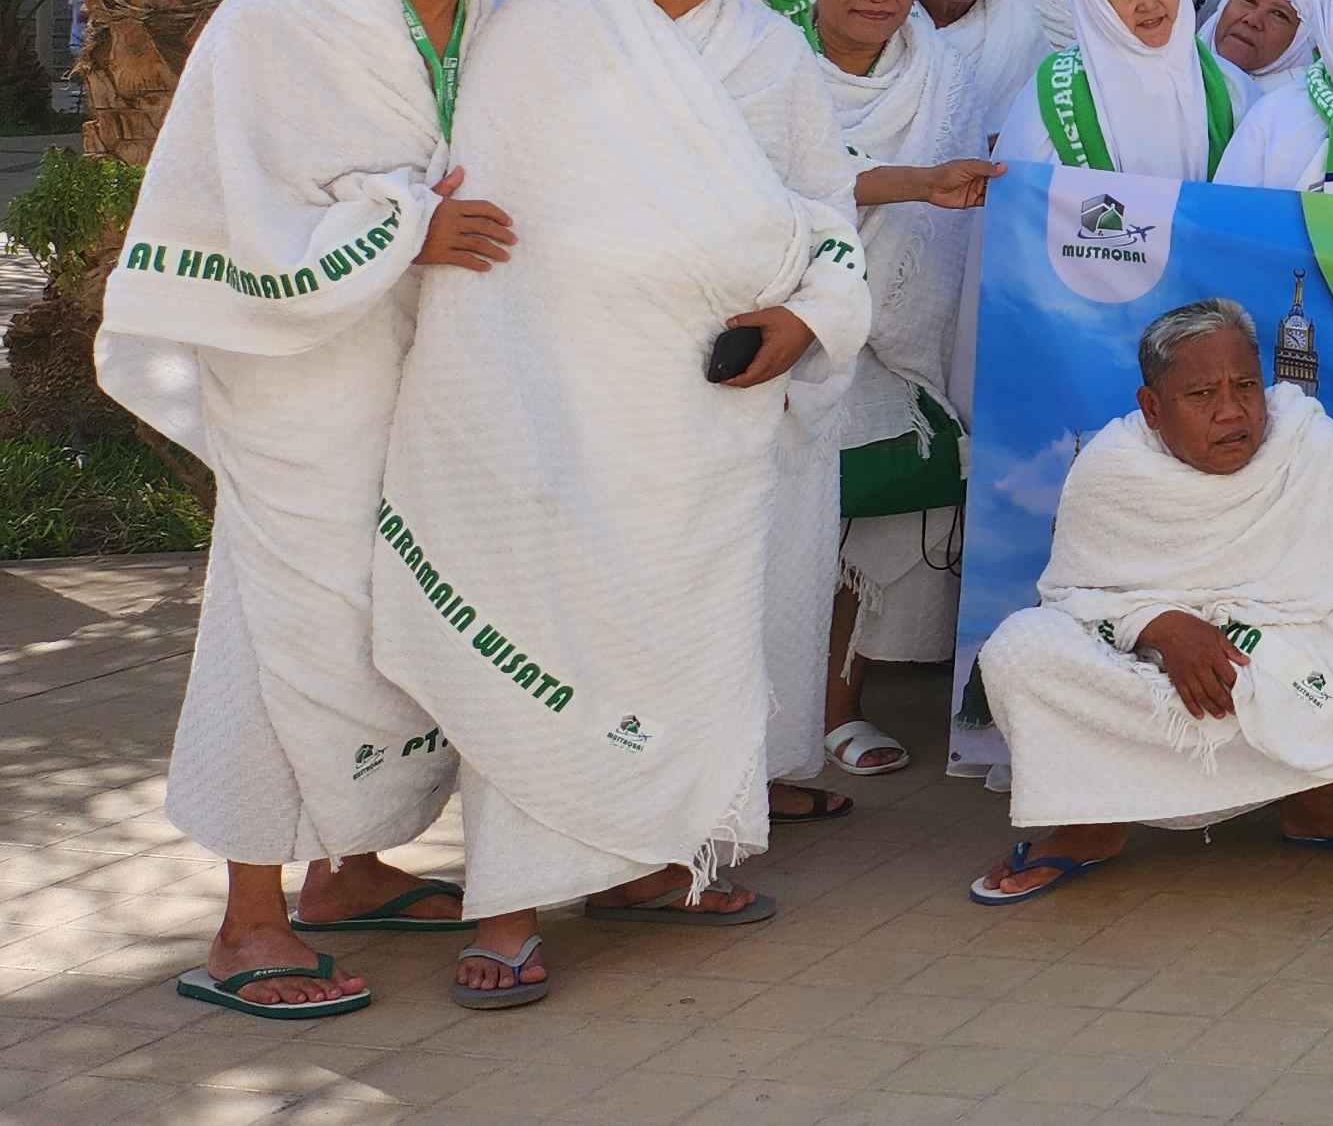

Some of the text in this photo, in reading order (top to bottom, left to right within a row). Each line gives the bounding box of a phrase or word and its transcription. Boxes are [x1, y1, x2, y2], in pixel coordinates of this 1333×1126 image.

[127, 242, 167, 273] AL
[319, 198, 401, 282] WISAT
[815, 238, 856, 269] PT.
[1062, 244, 1147, 264] MUSTAQBAL
[472, 624, 575, 713] WISATA
[401, 727, 448, 757] PT.
